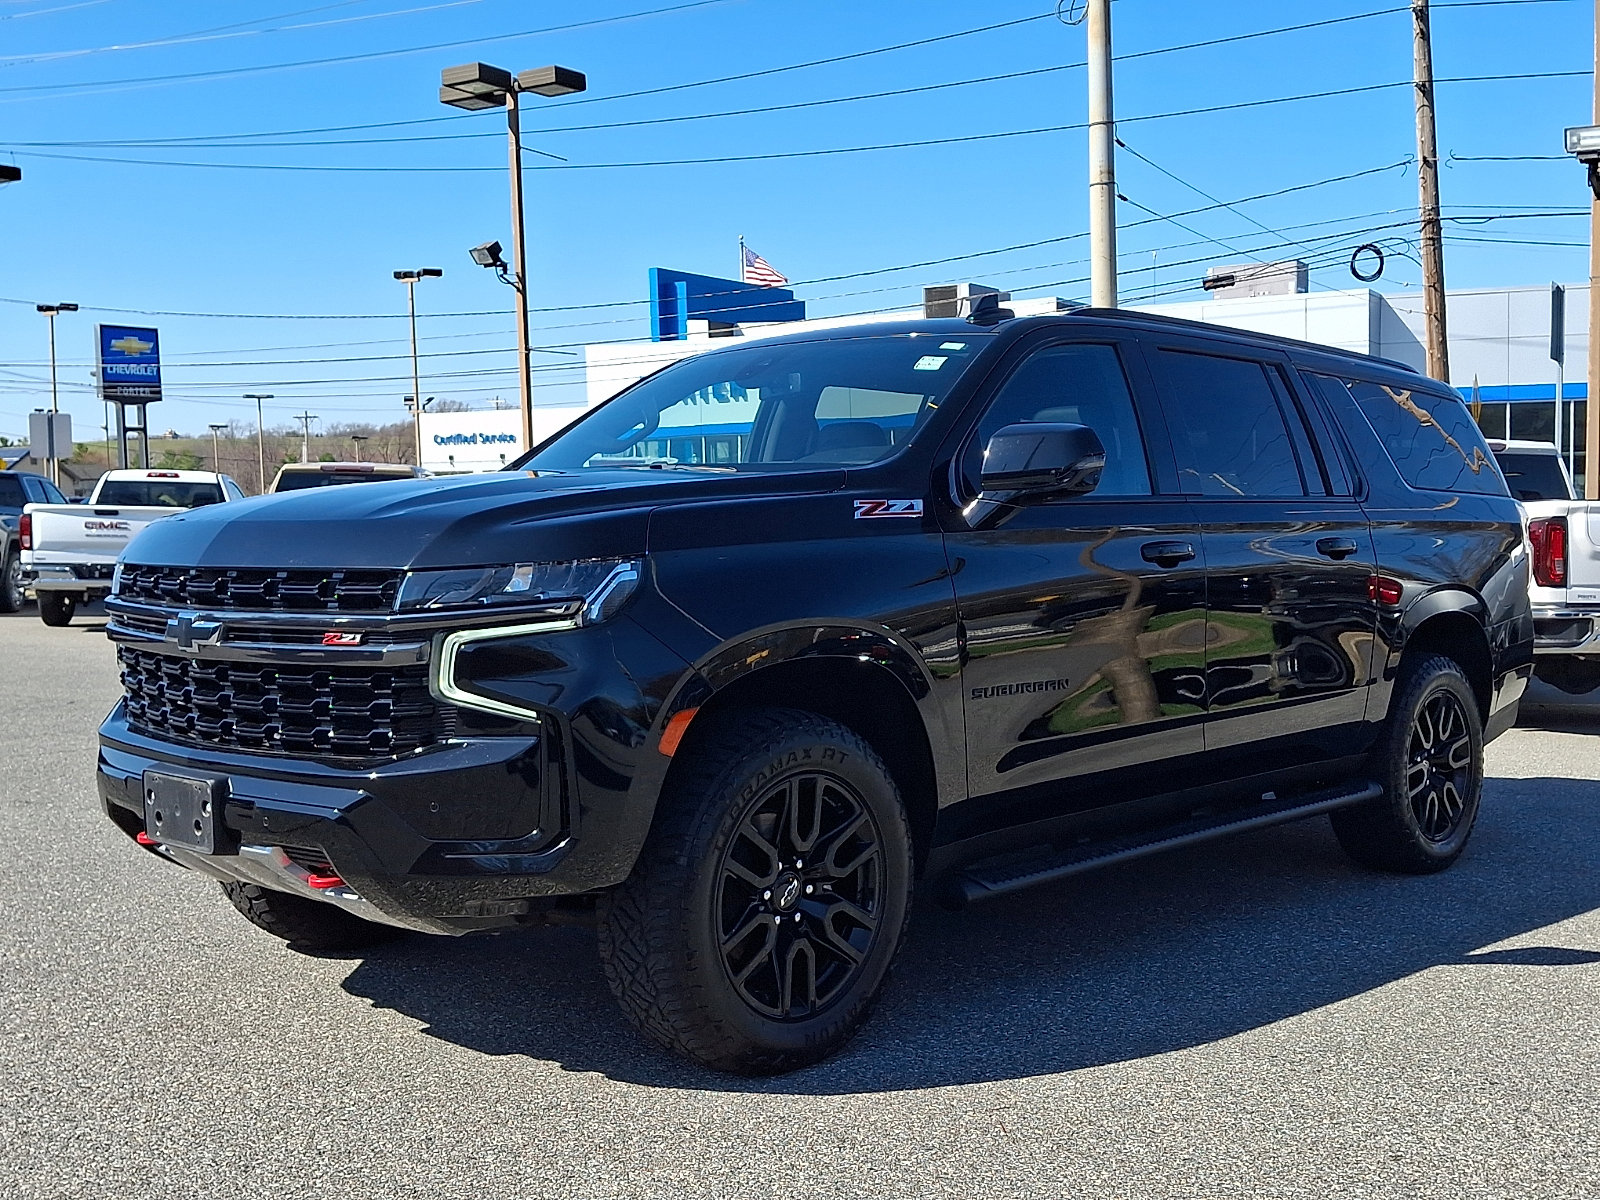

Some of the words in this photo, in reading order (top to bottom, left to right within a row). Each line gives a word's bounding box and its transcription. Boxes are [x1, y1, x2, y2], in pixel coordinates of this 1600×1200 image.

[107, 364, 158, 376] CHEVROLET
[433, 433, 477, 445] Certified
[479, 432, 516, 444] Service
[854, 499, 923, 519] Z71
[85, 521, 131, 531] GMC
[323, 633, 362, 645] Z71
[971, 679, 1069, 700] SUBURBAN
